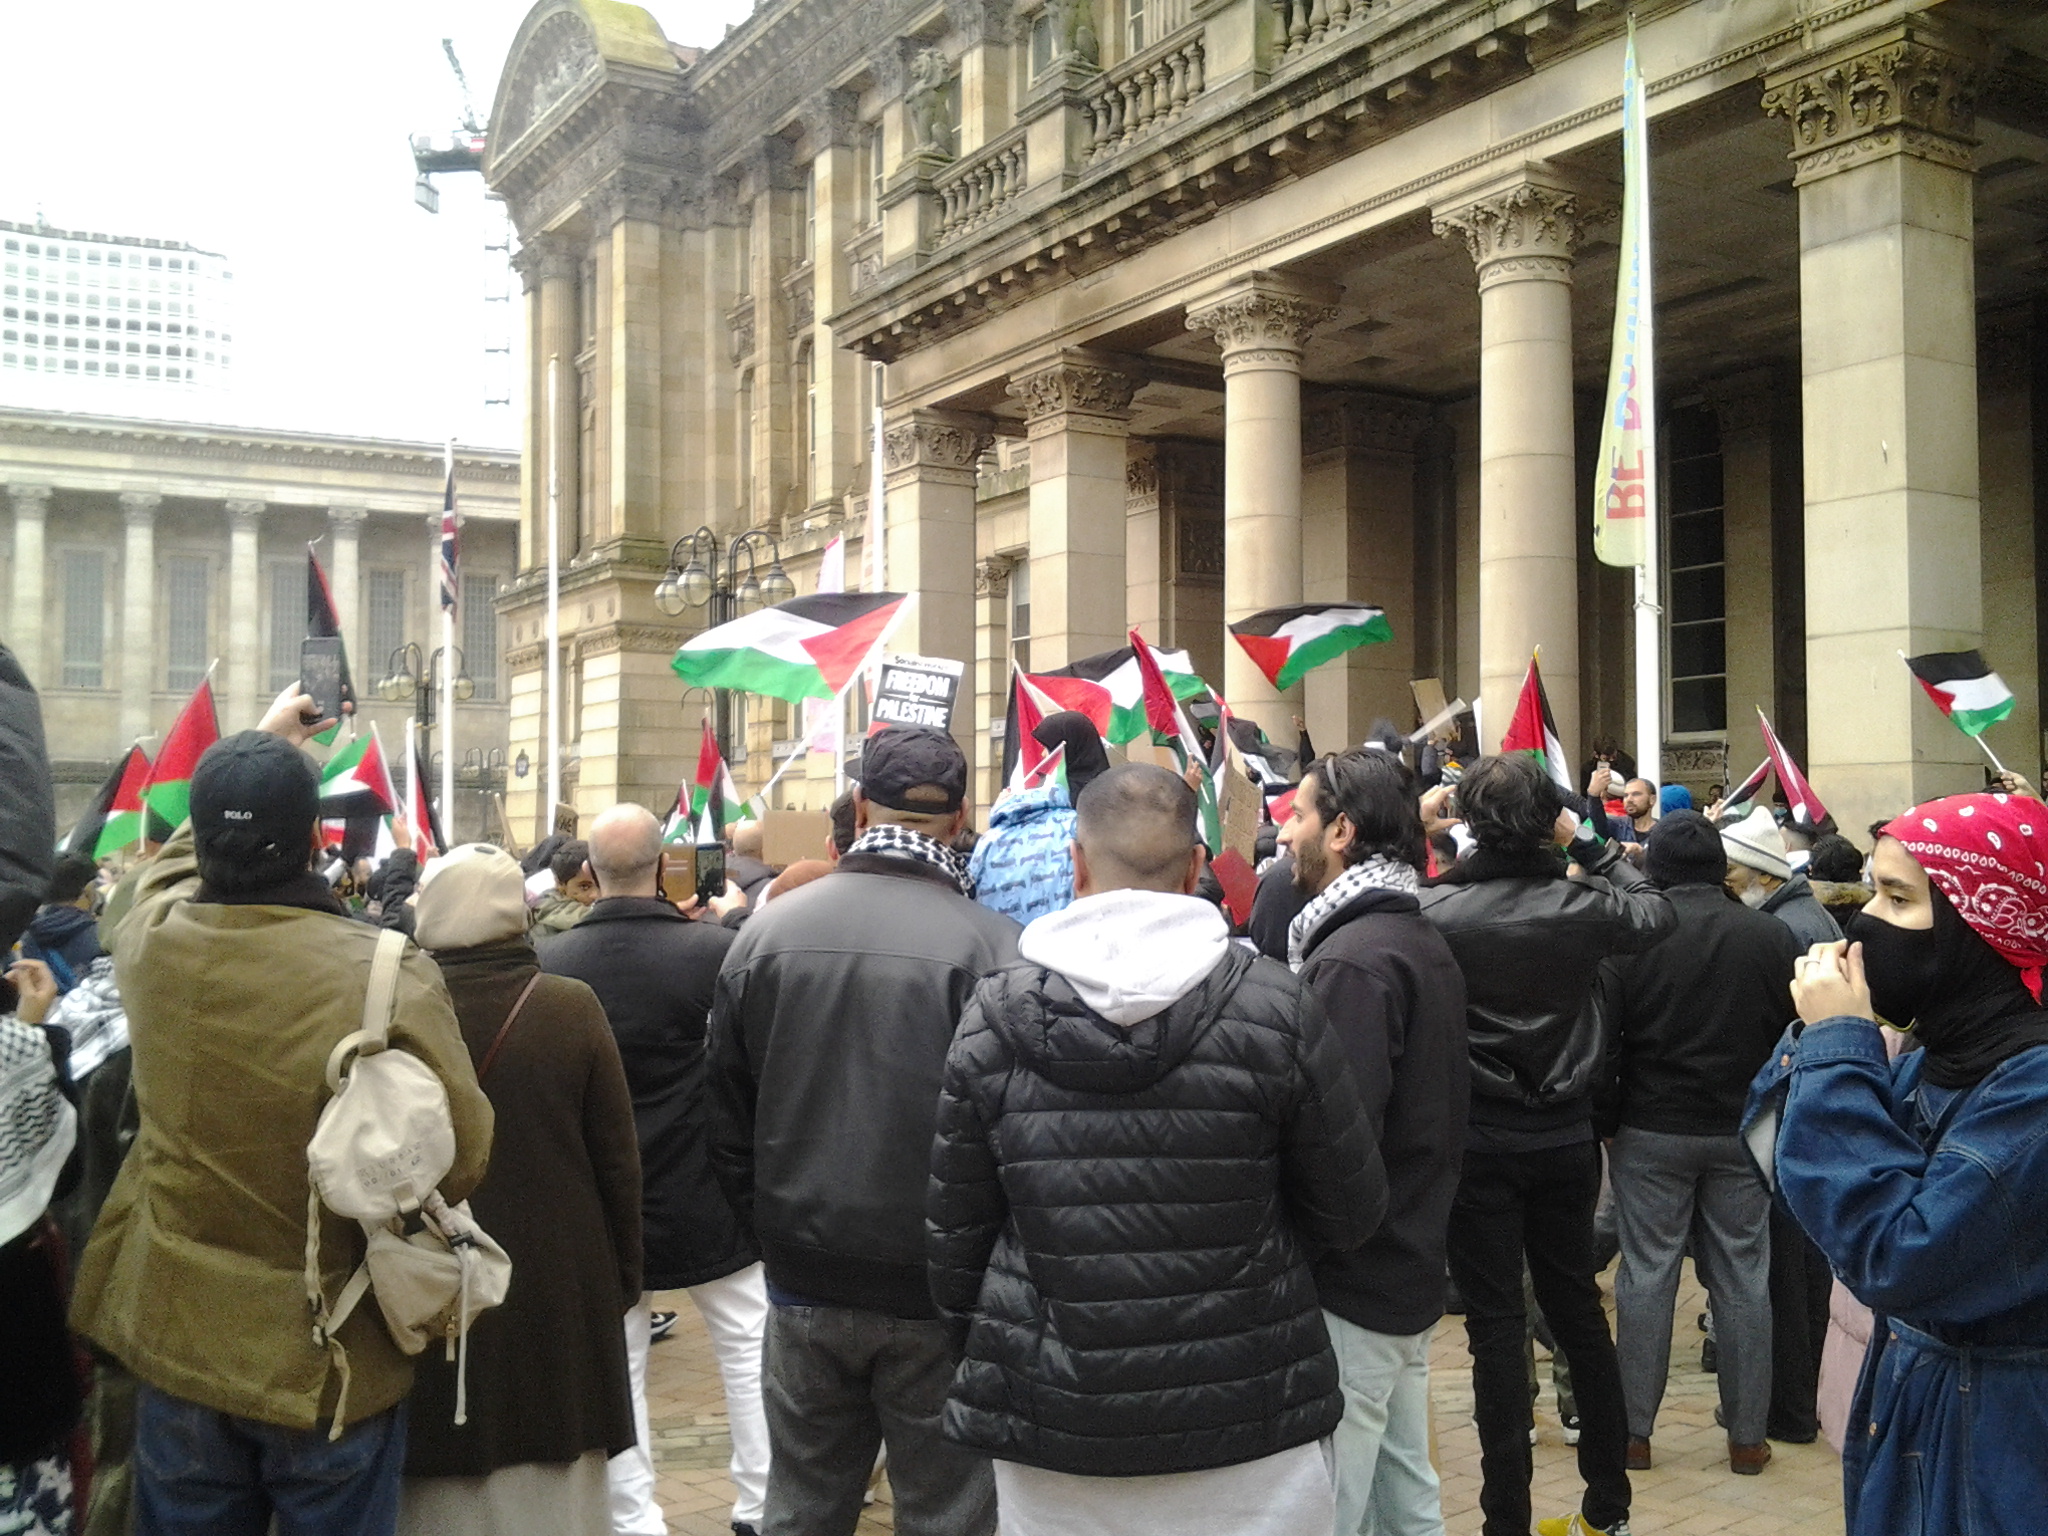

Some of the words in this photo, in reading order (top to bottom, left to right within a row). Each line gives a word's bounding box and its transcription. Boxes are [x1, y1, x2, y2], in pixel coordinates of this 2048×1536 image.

[885, 669, 951, 697] FREEDOM
[876, 698, 949, 728] PALESTINE
[223, 809, 253, 820] POLO
